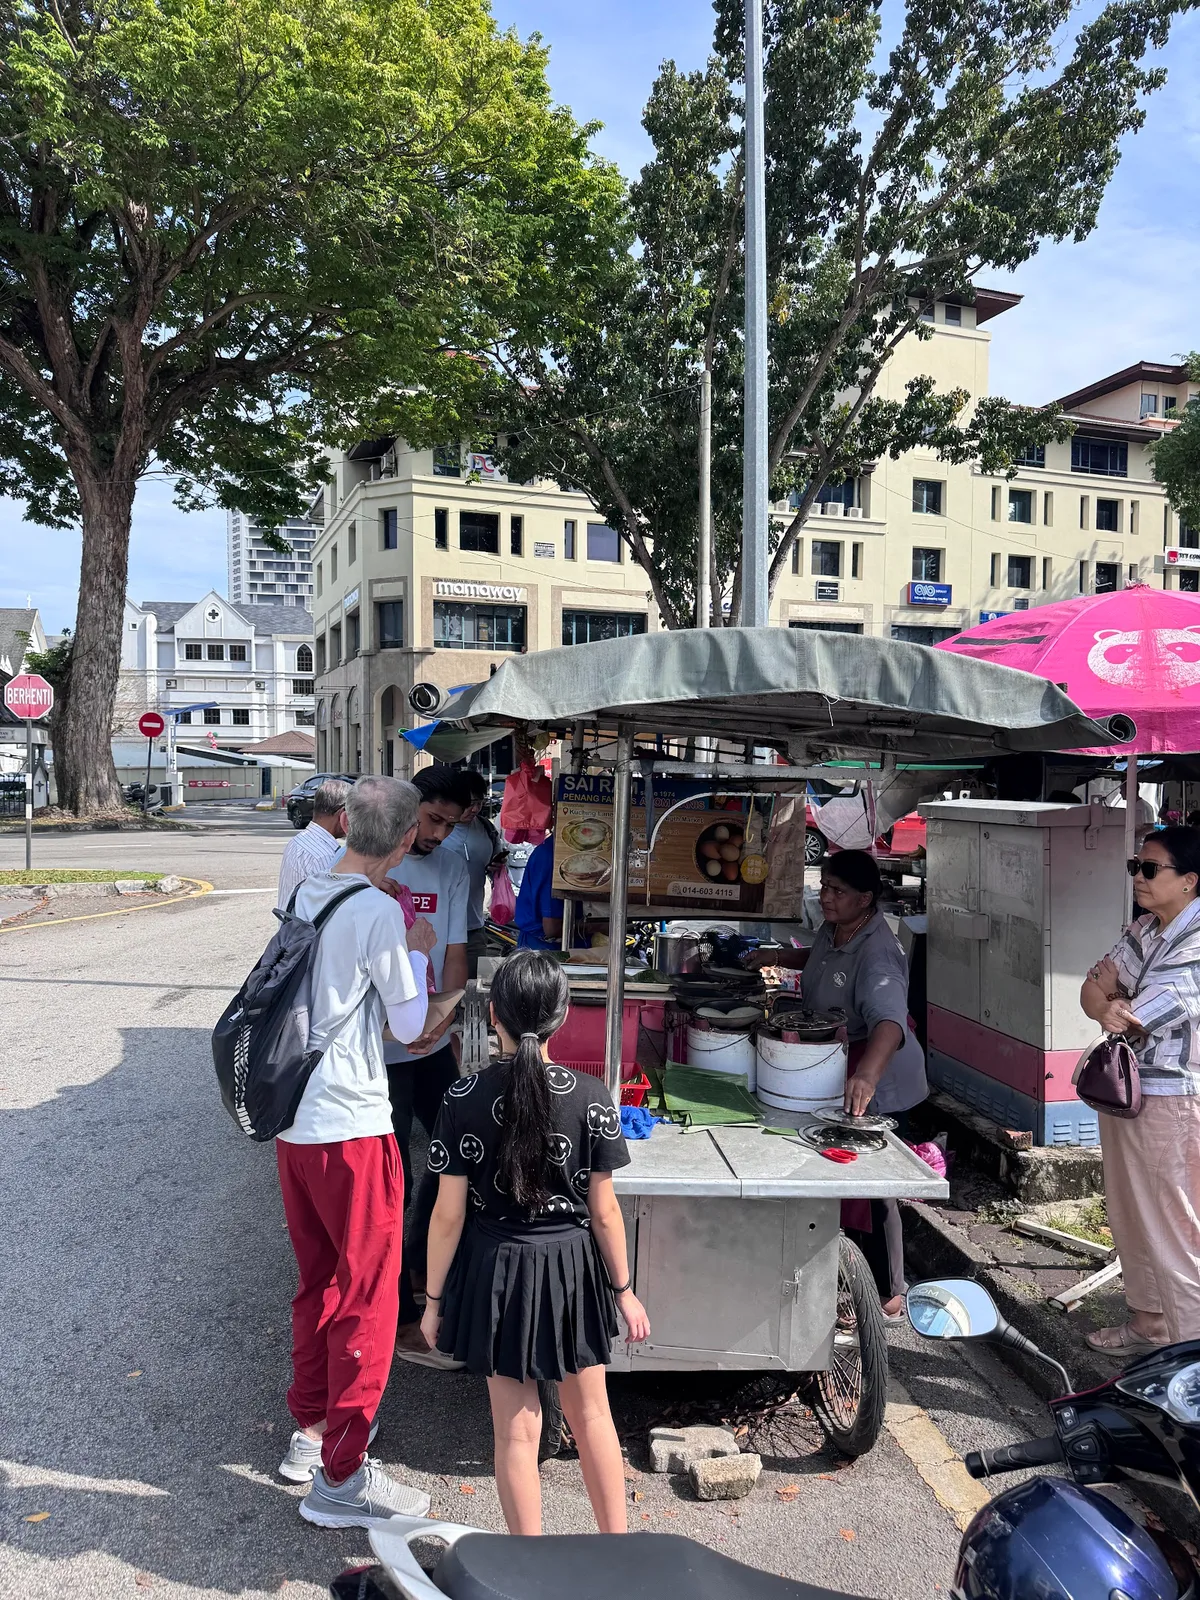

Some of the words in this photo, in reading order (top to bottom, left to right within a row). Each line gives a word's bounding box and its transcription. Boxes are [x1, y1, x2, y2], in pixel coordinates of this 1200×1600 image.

[436, 582, 523, 601] mamaway
[7, 687, 51, 705] BERHENTI
[564, 776, 594, 792] SAI
[563, 792, 600, 802] PENANG
[682, 886, 713, 895] 014-603
[715, 888, 733, 897] 4115
